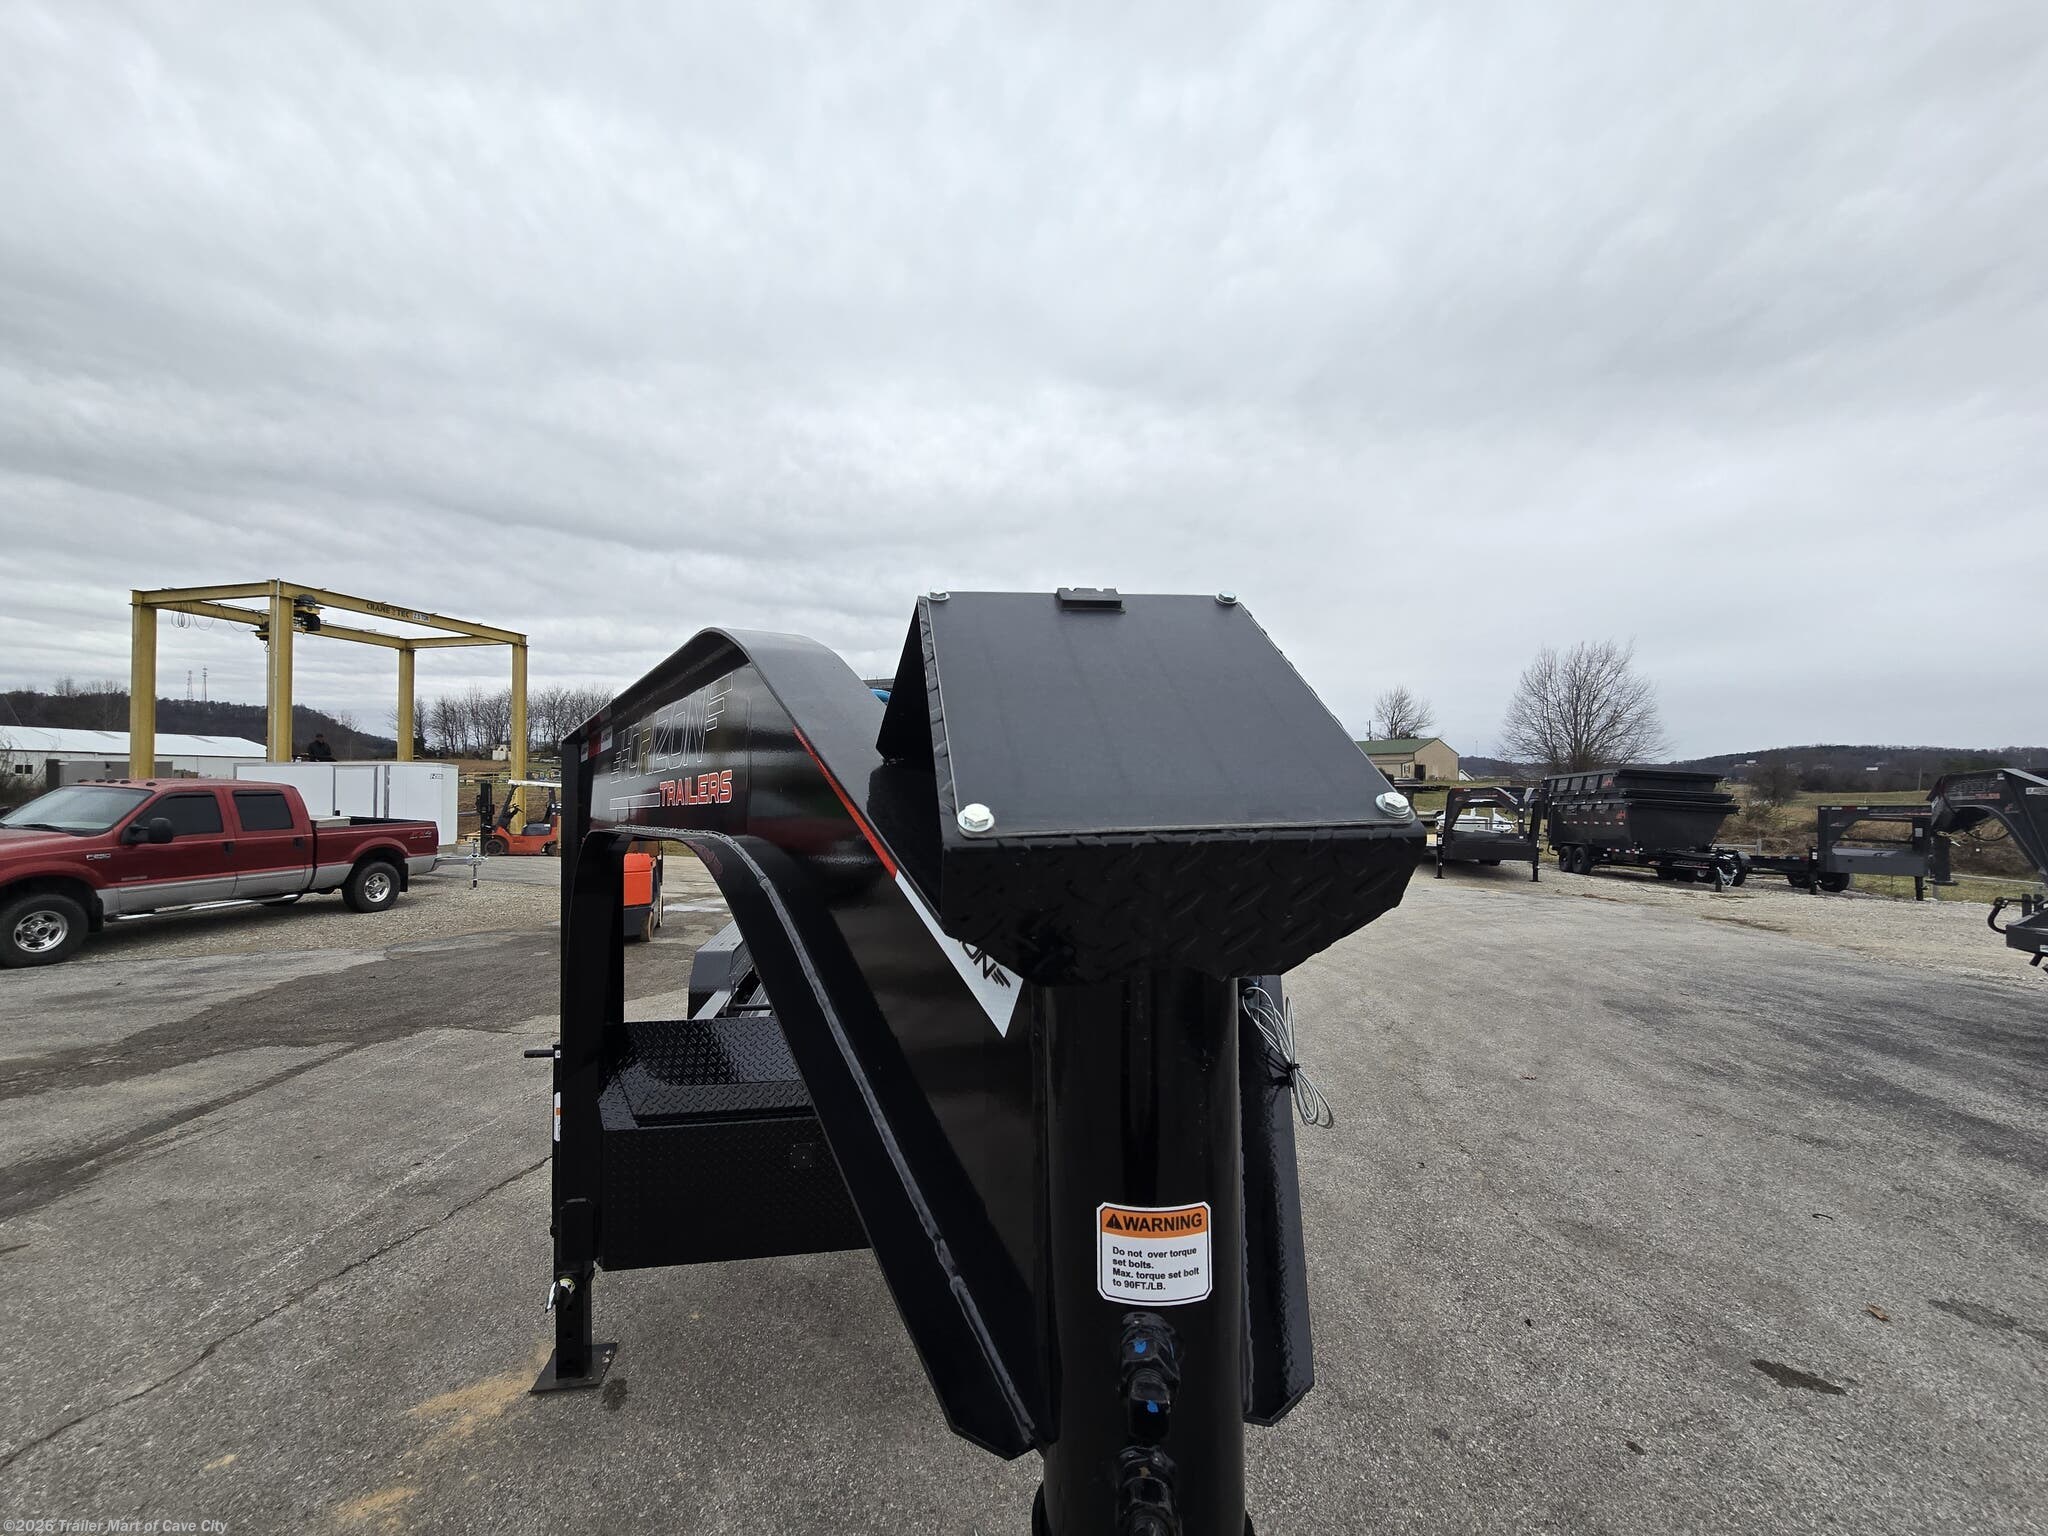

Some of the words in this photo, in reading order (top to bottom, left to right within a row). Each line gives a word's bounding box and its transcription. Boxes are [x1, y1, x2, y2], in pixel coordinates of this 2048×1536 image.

[611, 673, 733, 784] HORIZON
[659, 769, 733, 807] TRAILERS
[1122, 1212, 1202, 1232] WARNING
[1112, 1246, 1125, 1256] Do
[1170, 1248, 1197, 1257] torque
[1128, 1260, 1154, 1269] bolts.
[1112, 1268, 1134, 1278] Max.
[1136, 1272, 1166, 1281] torque
[1168, 1270, 1181, 1279] set
[1184, 1267, 1200, 1277] bolt
